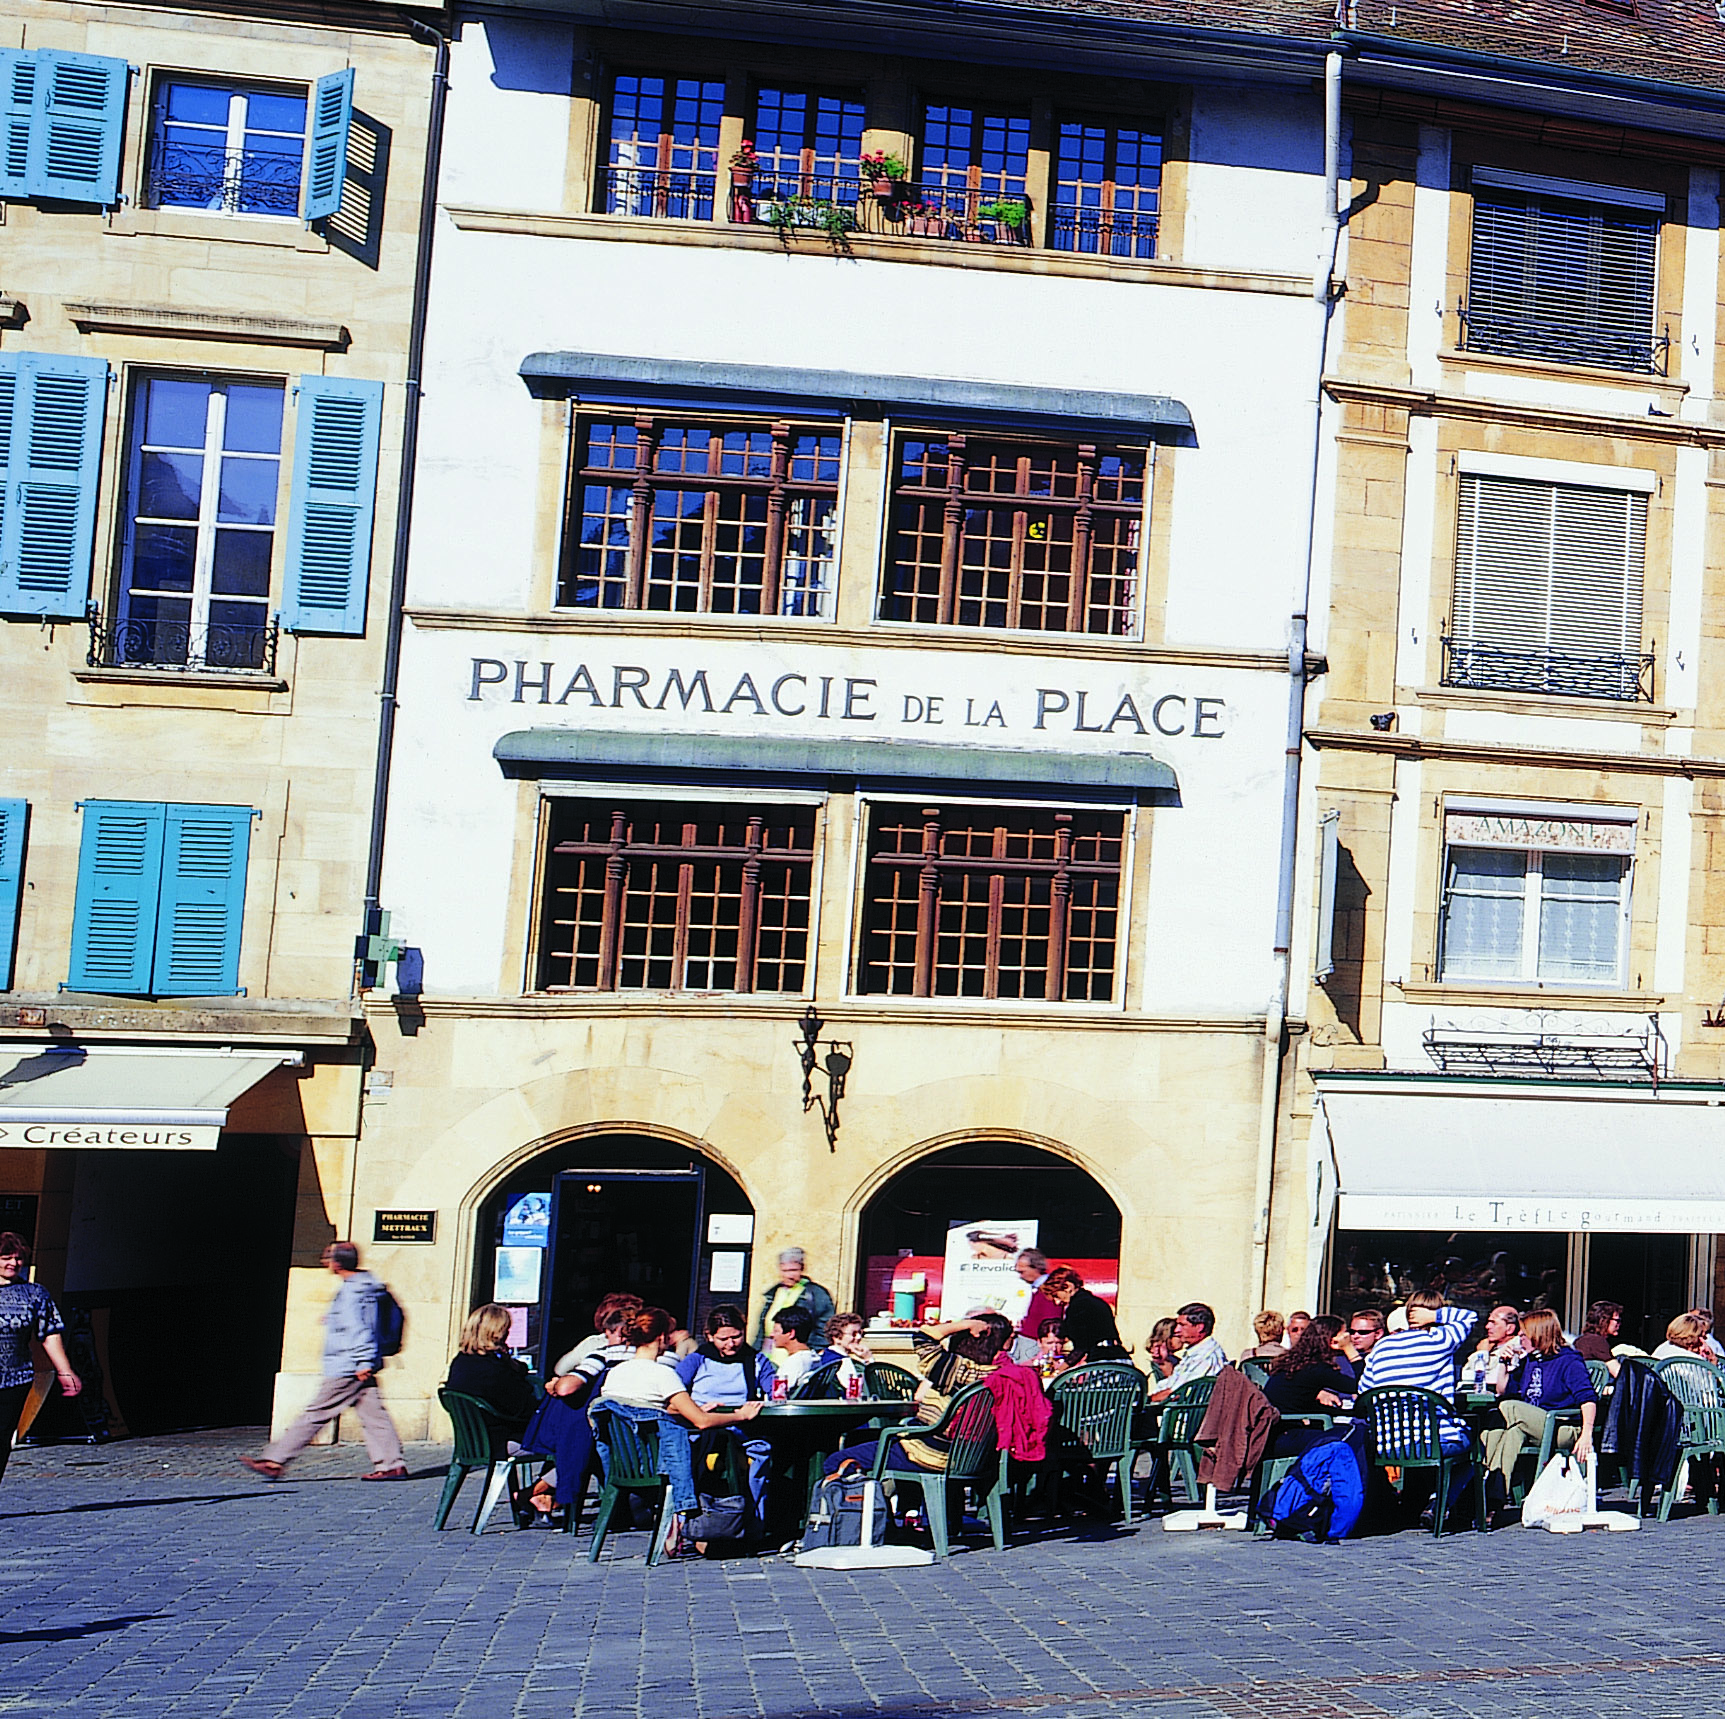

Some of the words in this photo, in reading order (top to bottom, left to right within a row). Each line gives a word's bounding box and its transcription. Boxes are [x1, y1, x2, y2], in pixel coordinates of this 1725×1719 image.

[467, 656, 879, 721] PHARMACIE
[902, 694, 943, 726] DE
[965, 697, 1007, 729] LA
[1031, 688, 1227, 740] PLACE
[1478, 816, 1599, 840] AMAZONE
[23, 1125, 193, 1146] Créateurs
[381, 1213, 429, 1222] PHARMACIE
[1580, 1210, 1661, 1230] gourmand
